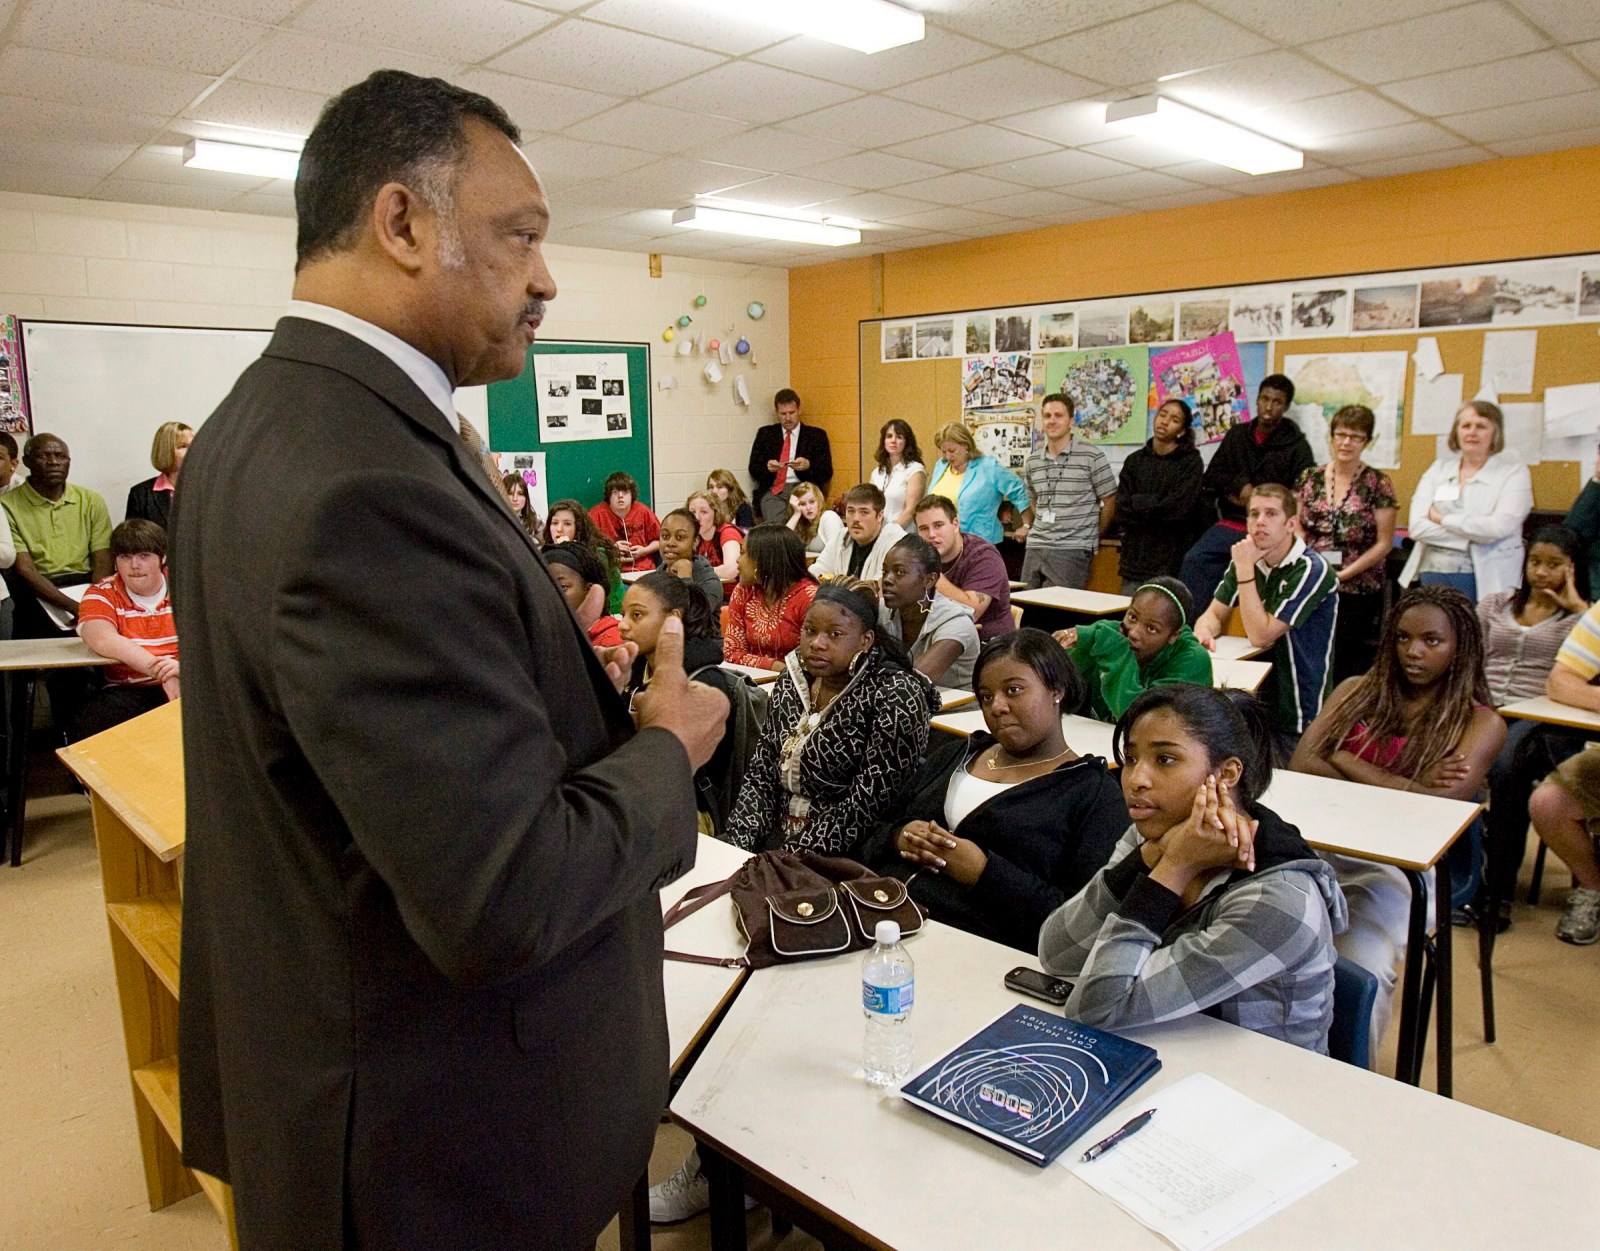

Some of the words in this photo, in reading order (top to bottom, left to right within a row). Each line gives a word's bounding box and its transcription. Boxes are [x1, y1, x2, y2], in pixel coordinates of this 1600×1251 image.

[1015, 1017, 1061, 1039] Harbour
[1022, 1013, 1047, 1028] High
[1052, 1024, 1098, 1045] District
[1066, 1035, 1093, 1051] Cole
[978, 1082, 1035, 1121] 2009
